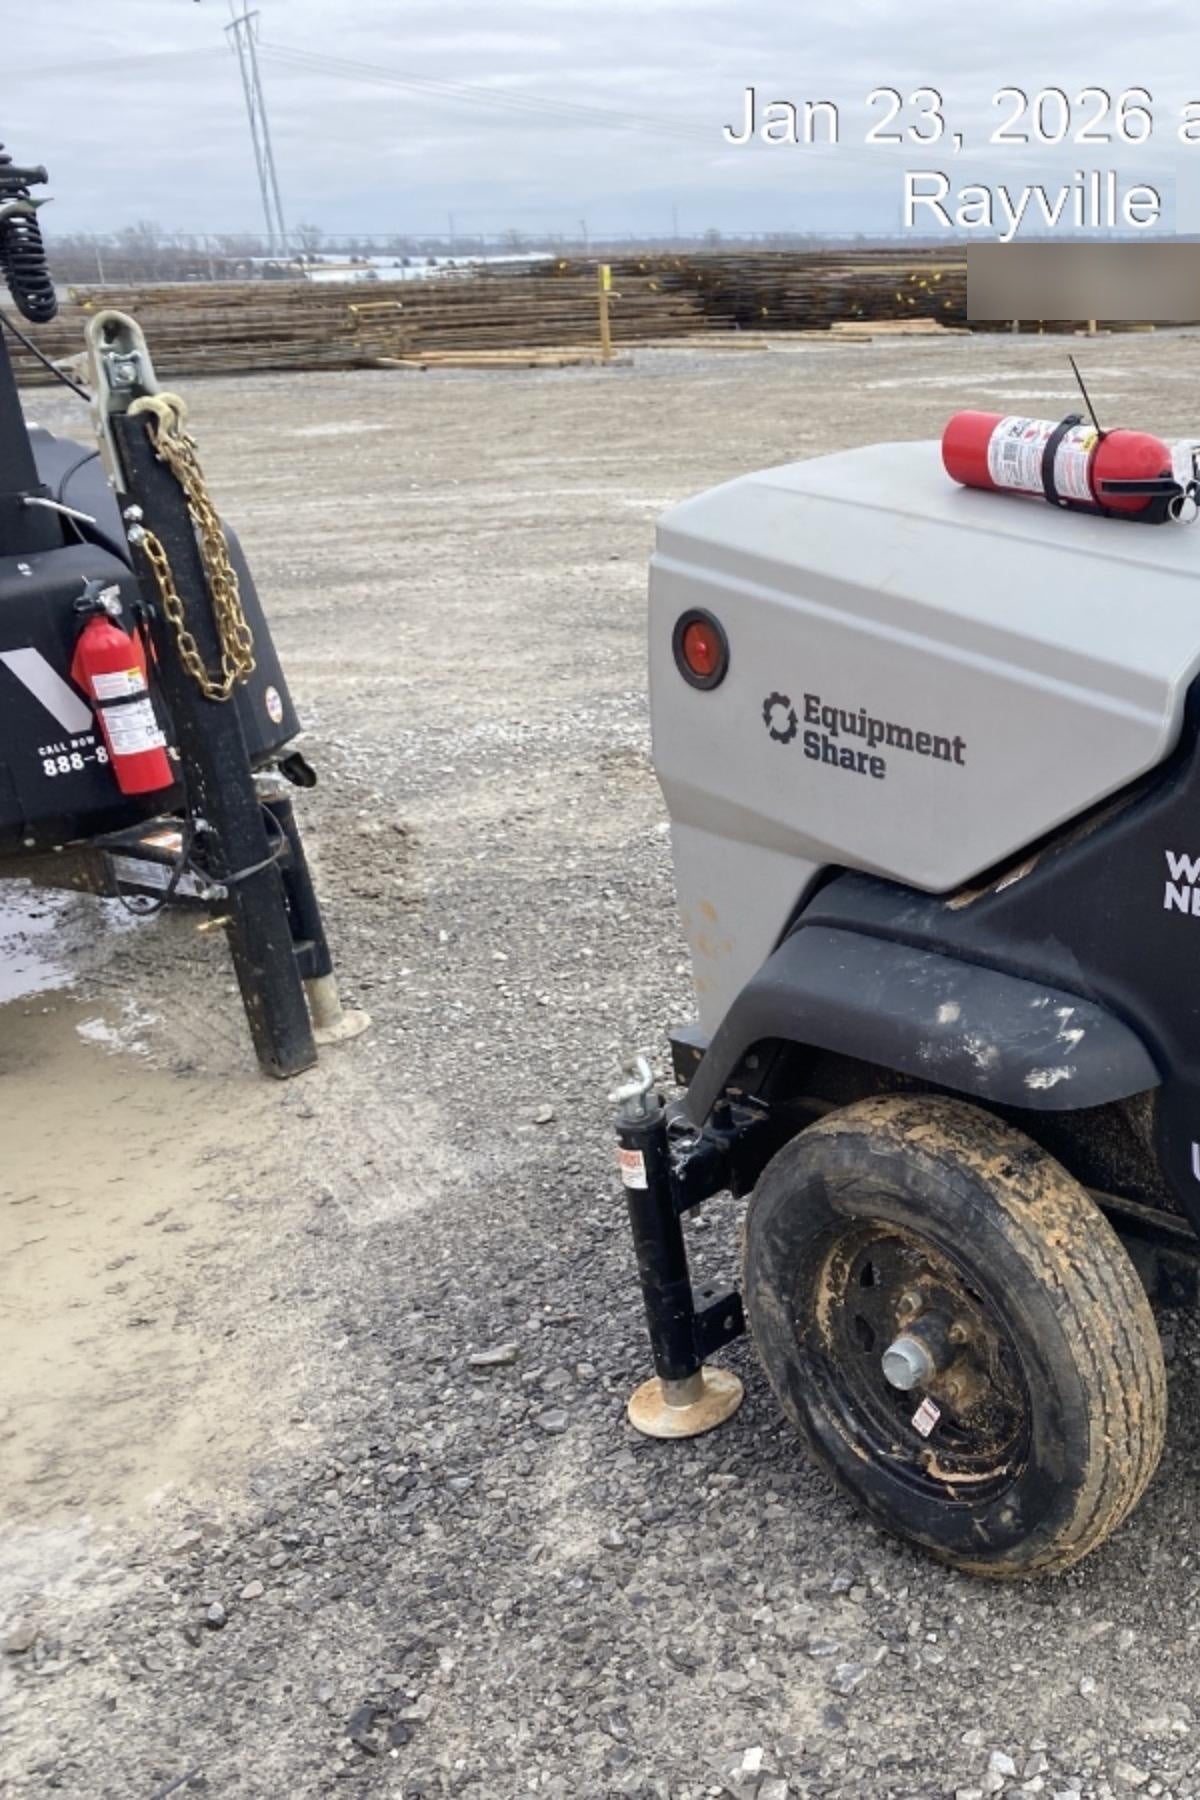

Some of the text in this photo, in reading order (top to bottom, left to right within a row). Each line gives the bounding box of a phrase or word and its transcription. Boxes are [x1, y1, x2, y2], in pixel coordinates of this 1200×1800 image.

[803, 693, 967, 766] Equipment
[803, 729, 887, 780] Share
[43, 745, 109, 777] 888-8
